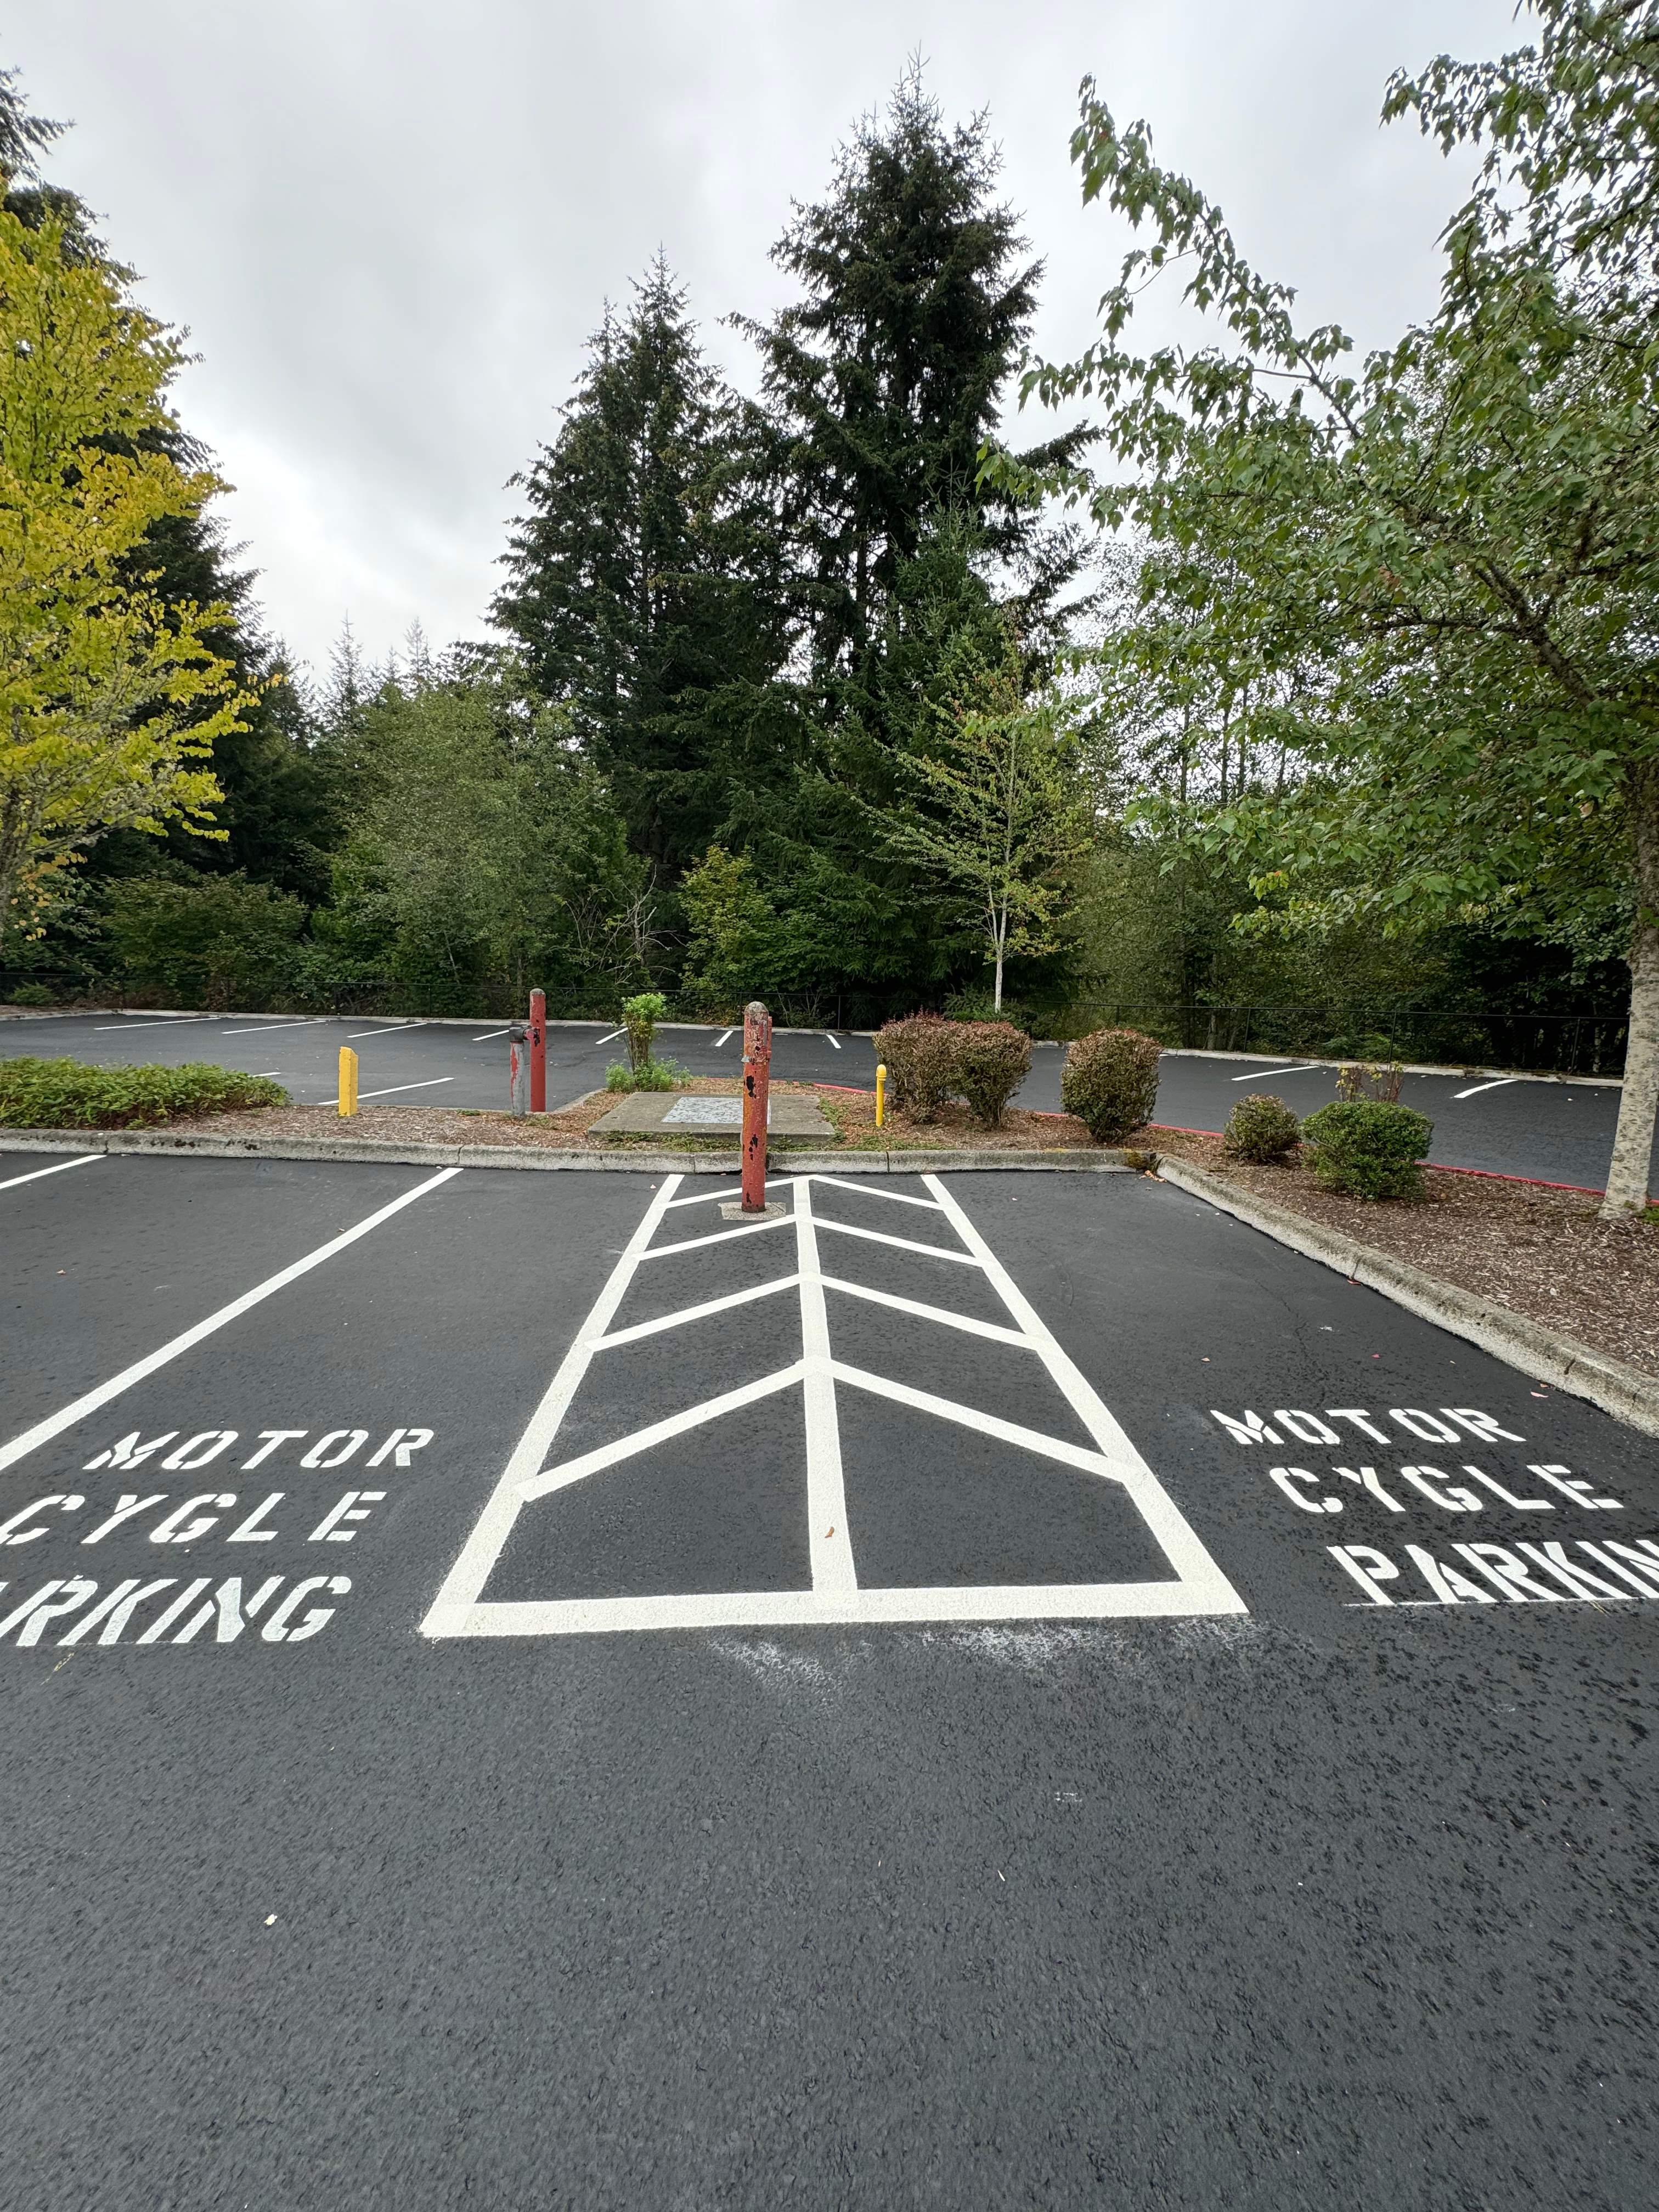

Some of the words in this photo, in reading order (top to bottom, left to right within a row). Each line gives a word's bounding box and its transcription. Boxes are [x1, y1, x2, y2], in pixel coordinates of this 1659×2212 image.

[1210, 1409, 1526, 1444] MOTOR
[82, 1429, 435, 1470] MOTOR
[0, 1575, 352, 1646] RKING
